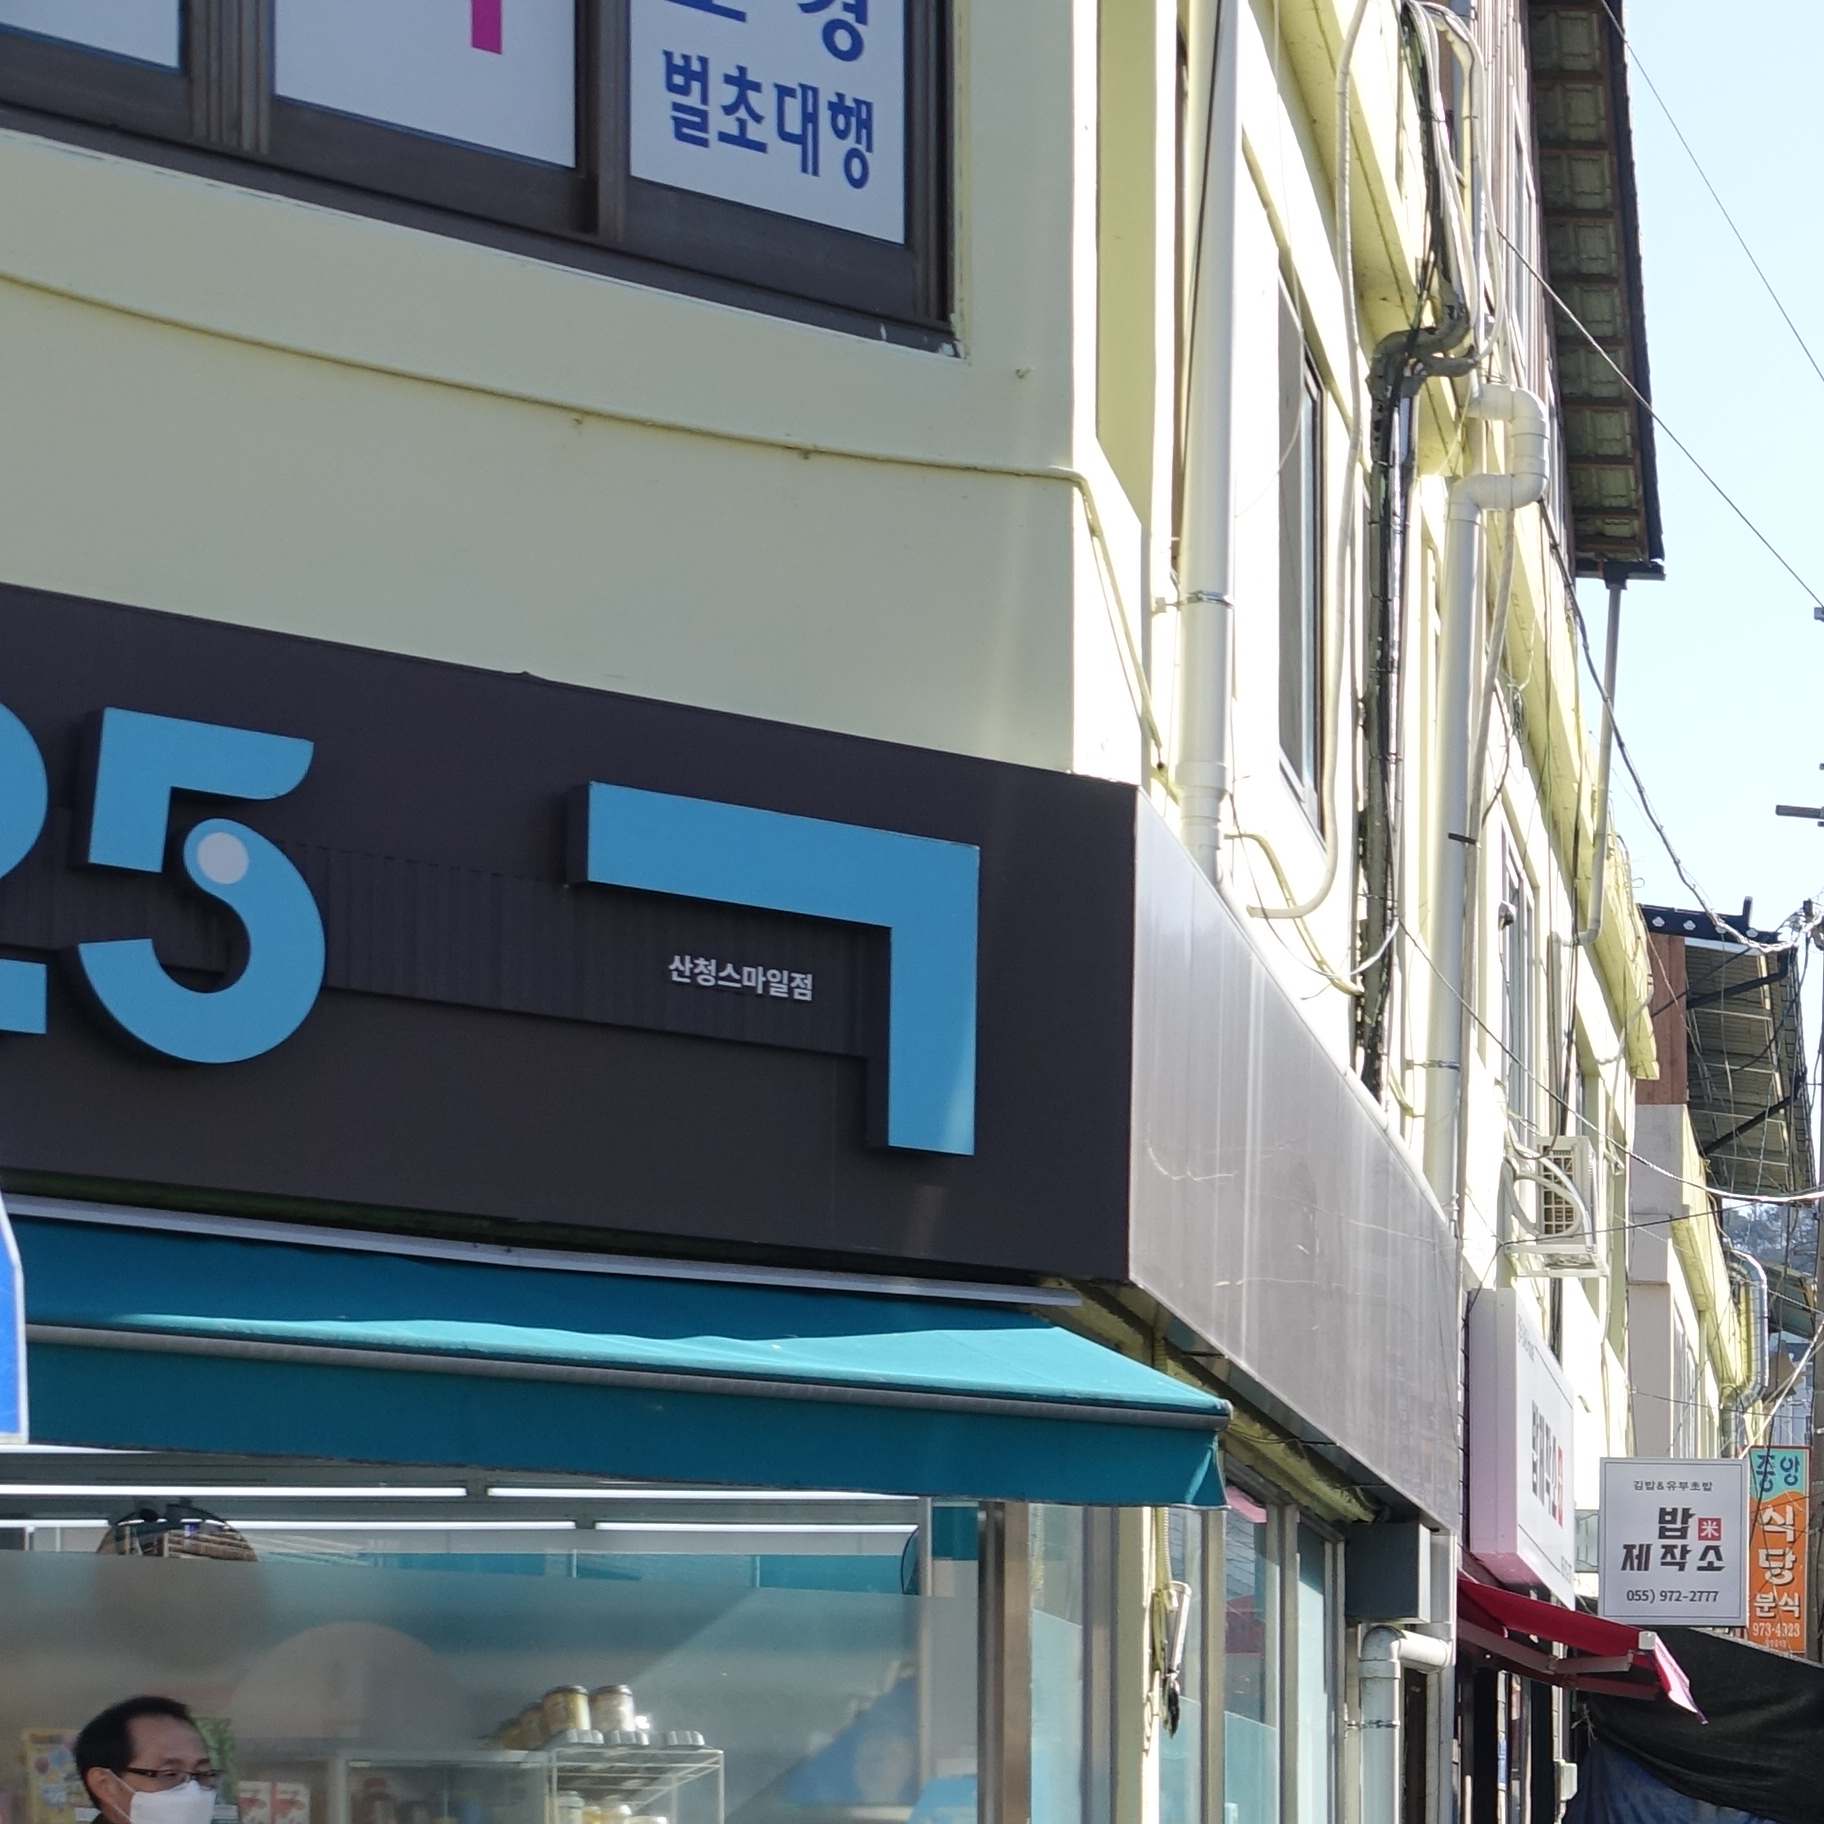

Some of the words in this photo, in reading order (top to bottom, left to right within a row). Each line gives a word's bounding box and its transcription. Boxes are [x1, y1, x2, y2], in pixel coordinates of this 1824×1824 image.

[661, 48, 874, 190] 벌초대행
[668, 954, 814, 1002] 산청스마일점
[1633, 1480, 1714, 1492] 김밥&유부초밥
[1657, 1506, 1697, 1540] 밥
[1620, 1542, 1727, 1572] 제작소
[1626, 1588, 1656, 1604] 055)
[1659, 1589, 1720, 1603] 972-2777
[1753, 1592, 1801, 1619] 분식
